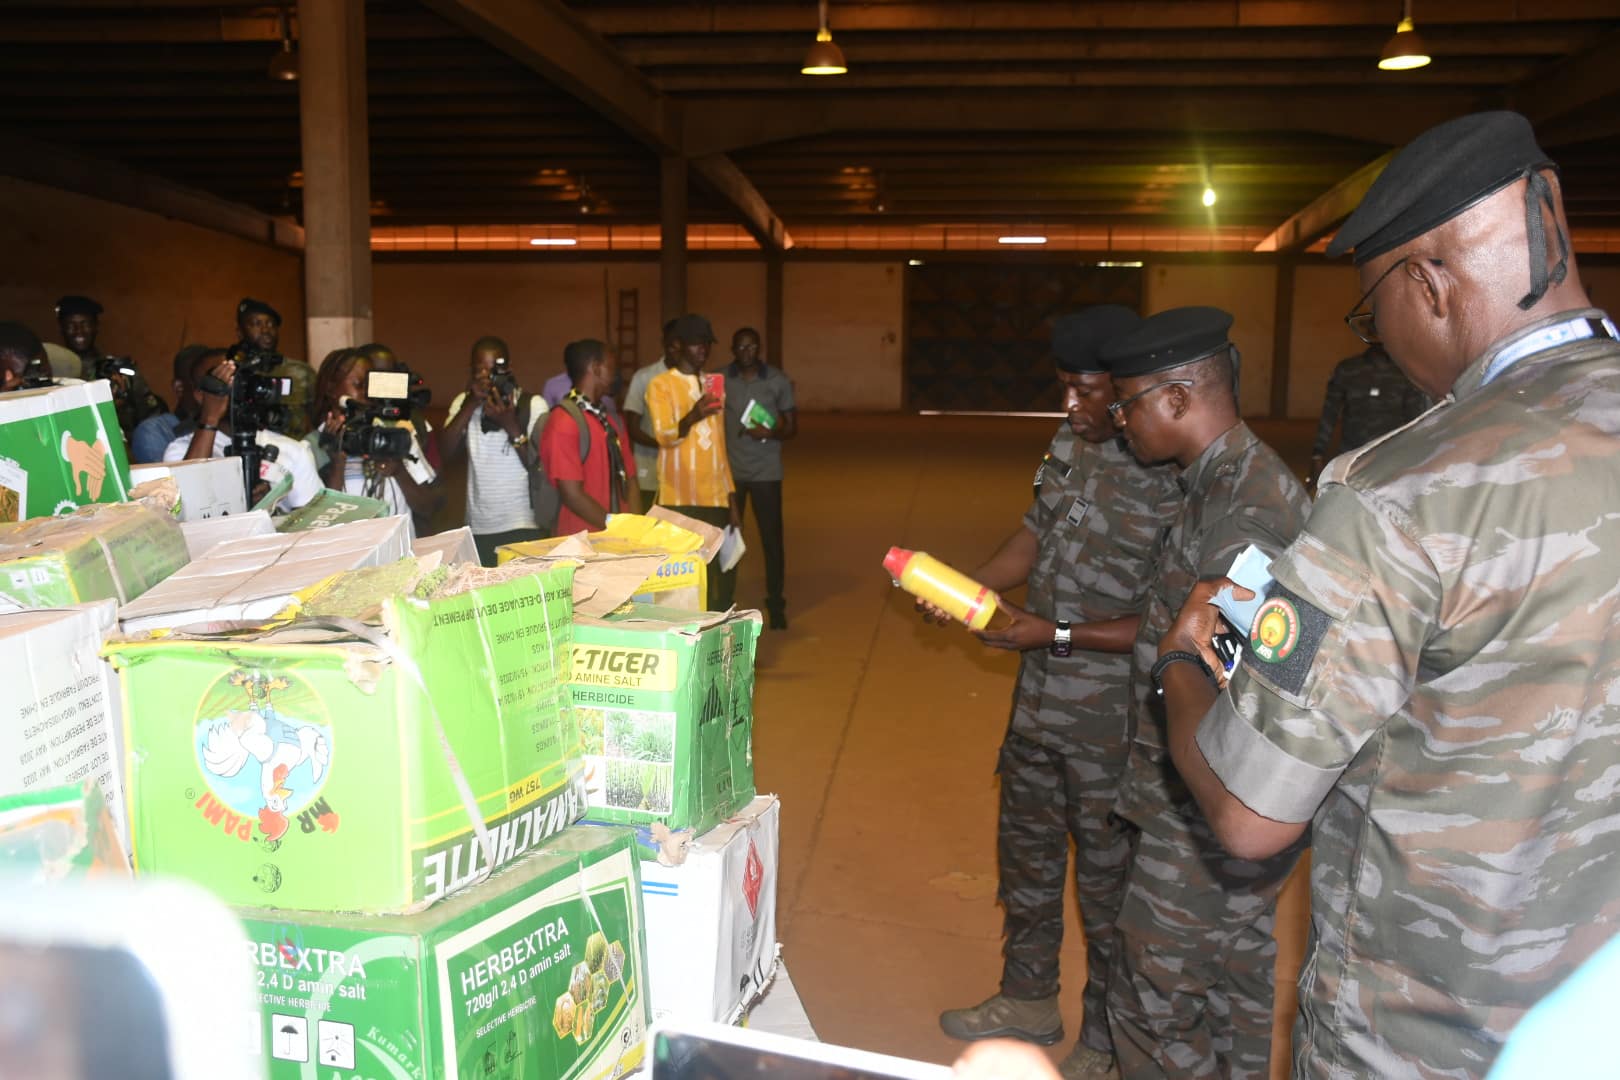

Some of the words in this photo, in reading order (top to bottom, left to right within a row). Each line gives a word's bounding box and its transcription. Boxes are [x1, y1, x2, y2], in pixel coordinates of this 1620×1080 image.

[656, 561, 695, 578] 480SL
[575, 672, 611, 684] AMINE
[614, 675, 643, 687] SALT
[572, 690, 635, 705] HERBICIDE
[509, 787, 524, 803] WG
[525, 776, 542, 796] 757
[460, 916, 570, 996] HERBEXTRA
[501, 975, 517, 997] 2,4
[518, 968, 528, 985] D
[529, 955, 552, 979] amin
[554, 943, 572, 964] salt
[257, 970, 278, 990] 2,4
[283, 974, 294, 991] D
[298, 979, 334, 994] amin
[339, 983, 367, 1001] salt
[475, 1014, 507, 1039] SELECTIVE
